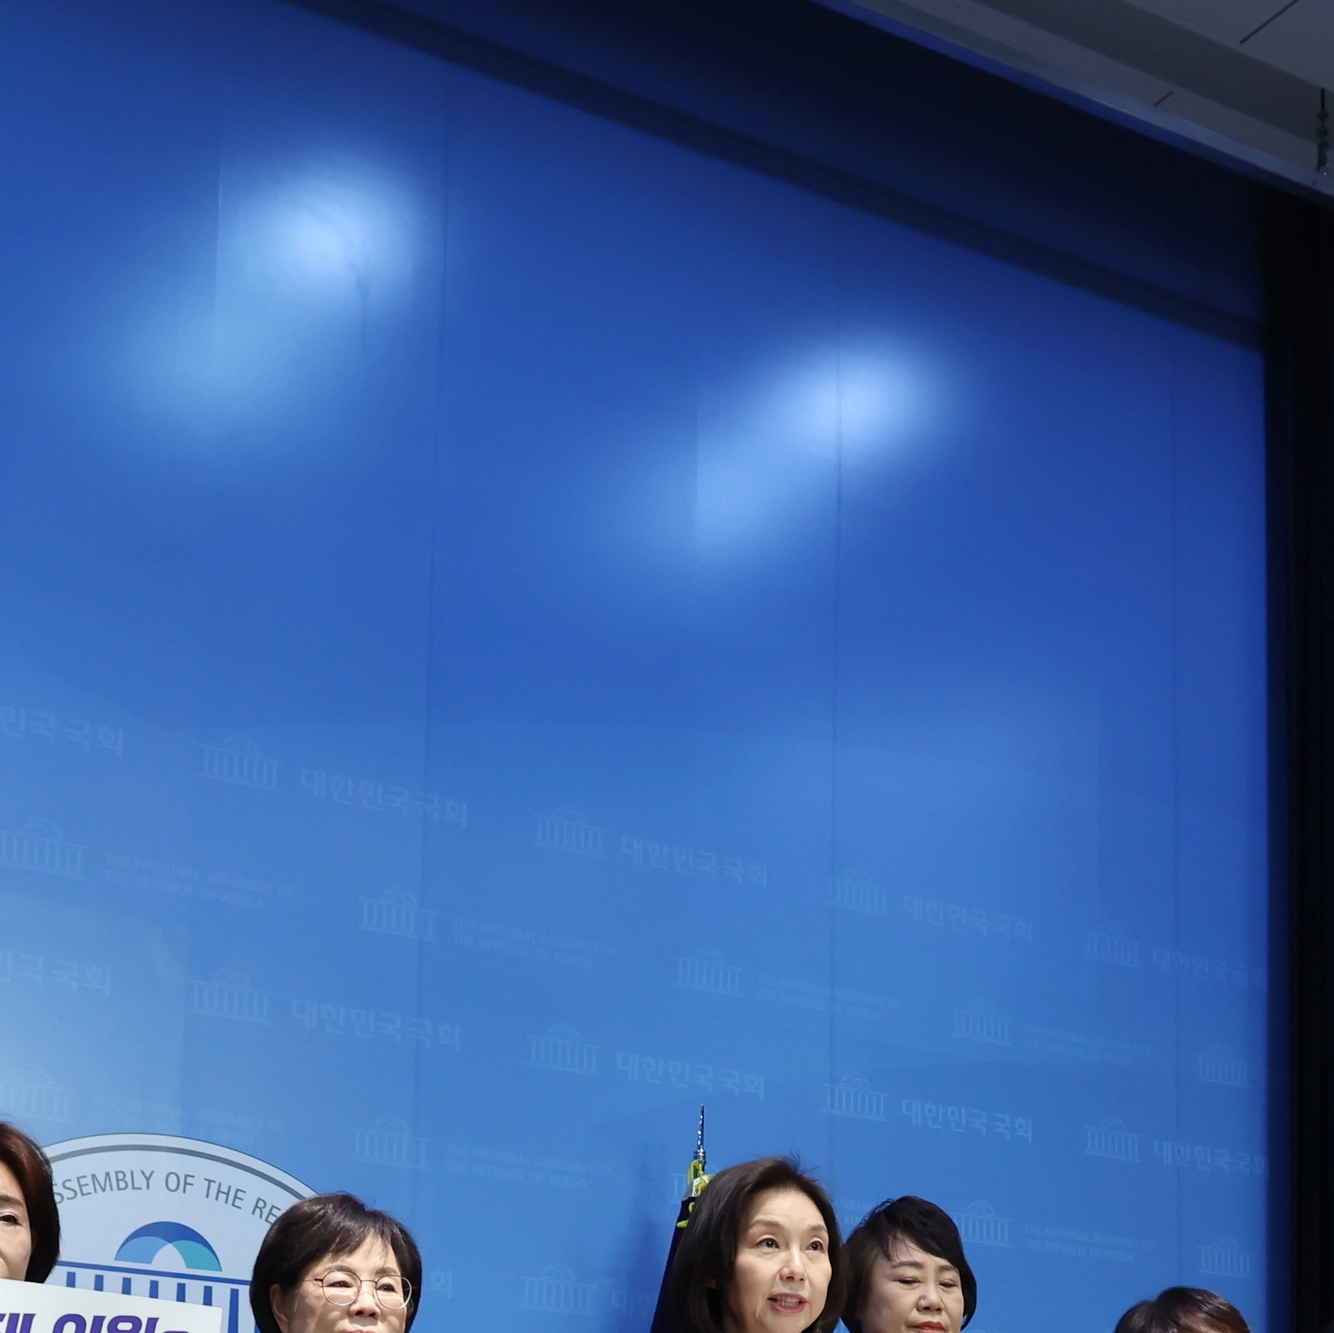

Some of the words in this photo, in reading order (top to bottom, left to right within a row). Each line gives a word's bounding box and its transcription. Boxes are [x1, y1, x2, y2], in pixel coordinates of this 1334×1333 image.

[53, 1169, 155, 1205] SSEMBLY
[165, 1171, 195, 1194] OF
[204, 1178, 247, 1210] THE
